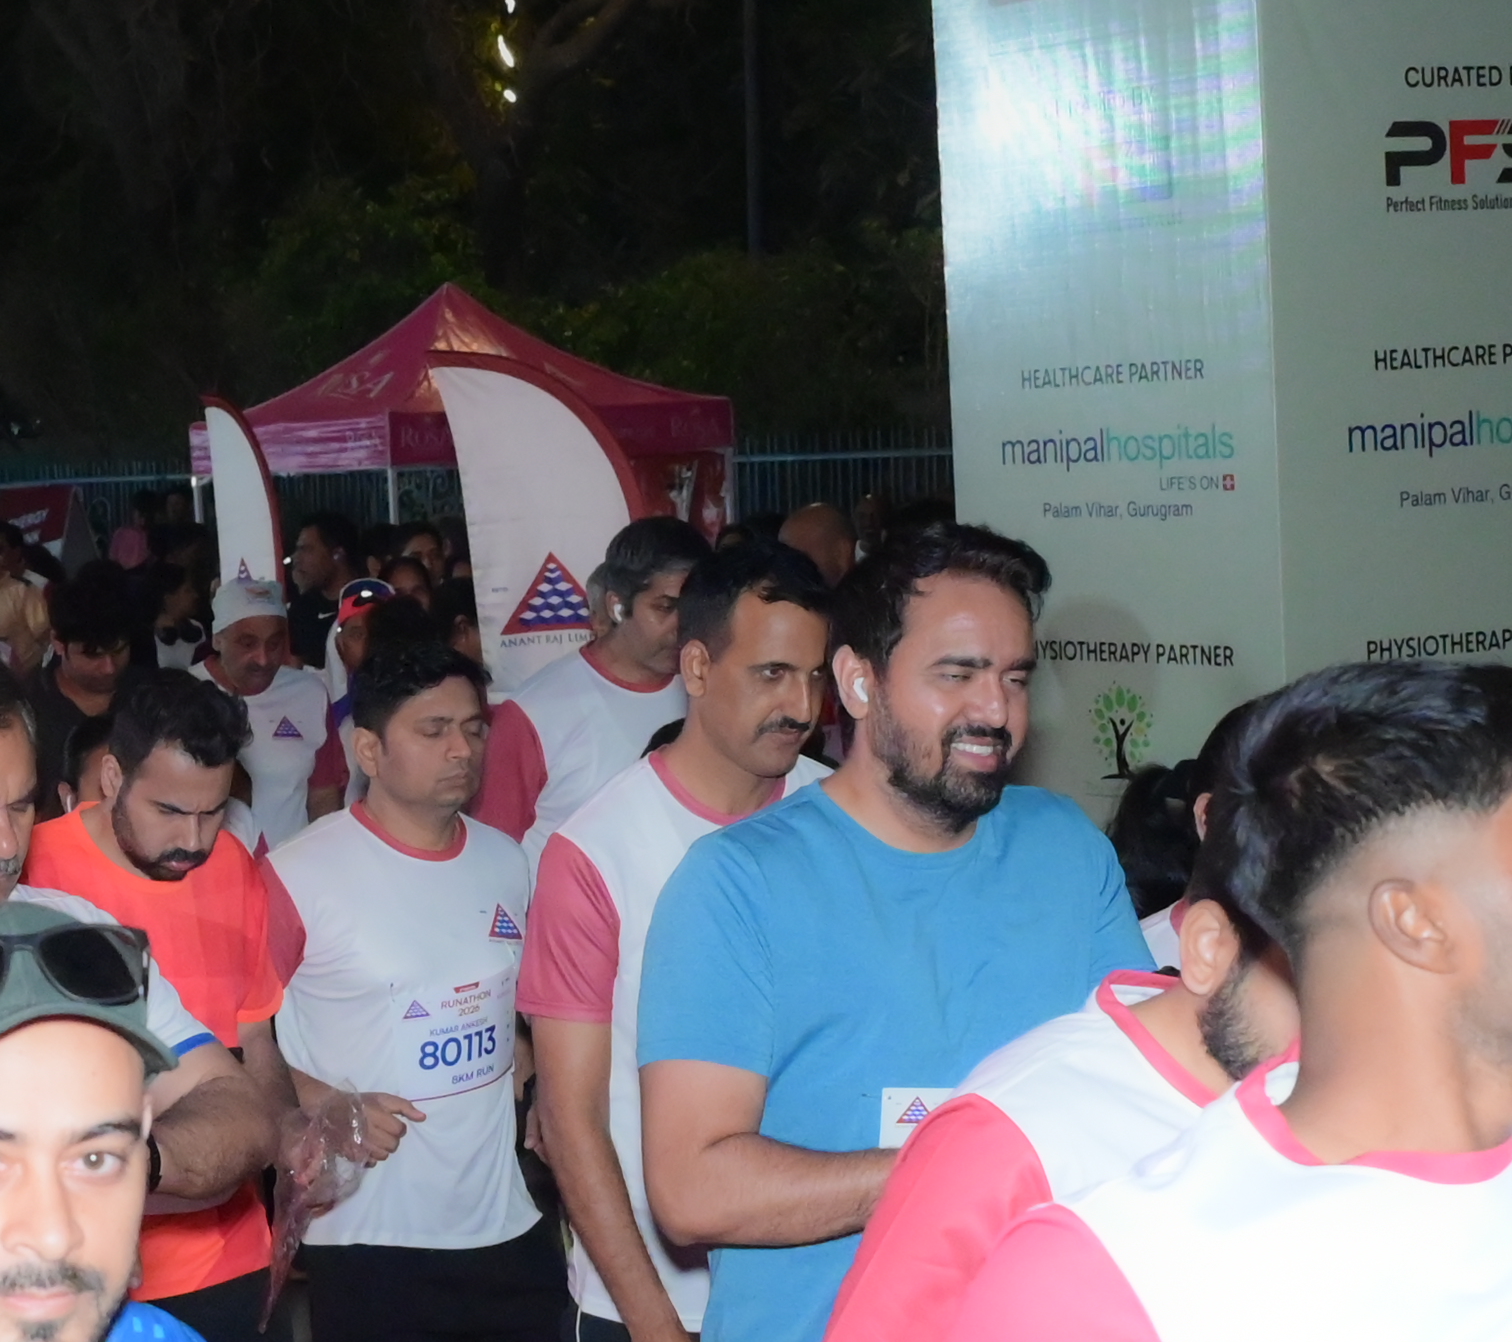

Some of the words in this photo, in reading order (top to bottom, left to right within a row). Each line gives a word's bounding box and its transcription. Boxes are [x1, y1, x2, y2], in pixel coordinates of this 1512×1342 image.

[1404, 65, 1503, 88] CURATED
[1386, 196, 1426, 213] Perfect
[1429, 195, 1469, 211] Fitness
[1374, 344, 1498, 371] HEALTHCARE
[1021, 364, 1124, 390] HEALTHCARE
[1129, 359, 1205, 383] PARTNER
[1159, 475, 1197, 491] LIFE'S
[1199, 475, 1219, 490] ON
[1400, 490, 1447, 508] Palam
[1451, 486, 1494, 505] Vihar,
[1043, 502, 1082, 519] Palam
[1127, 500, 1194, 521] Gurugram
[500, 635, 543, 648] ANANT
[545, 634, 564, 645] RAJ
[568, 632, 597, 643] LIMI
[1155, 643, 1235, 667] PARTNER
[440, 989, 492, 1010] RUNATHON
[458, 1005, 481, 1018] 2026
[429, 1025, 459, 1037] KUMAR
[418, 1024, 497, 1071] 80113
[451, 1070, 474, 1085] 8KM
[476, 1063, 495, 1078] RUN
